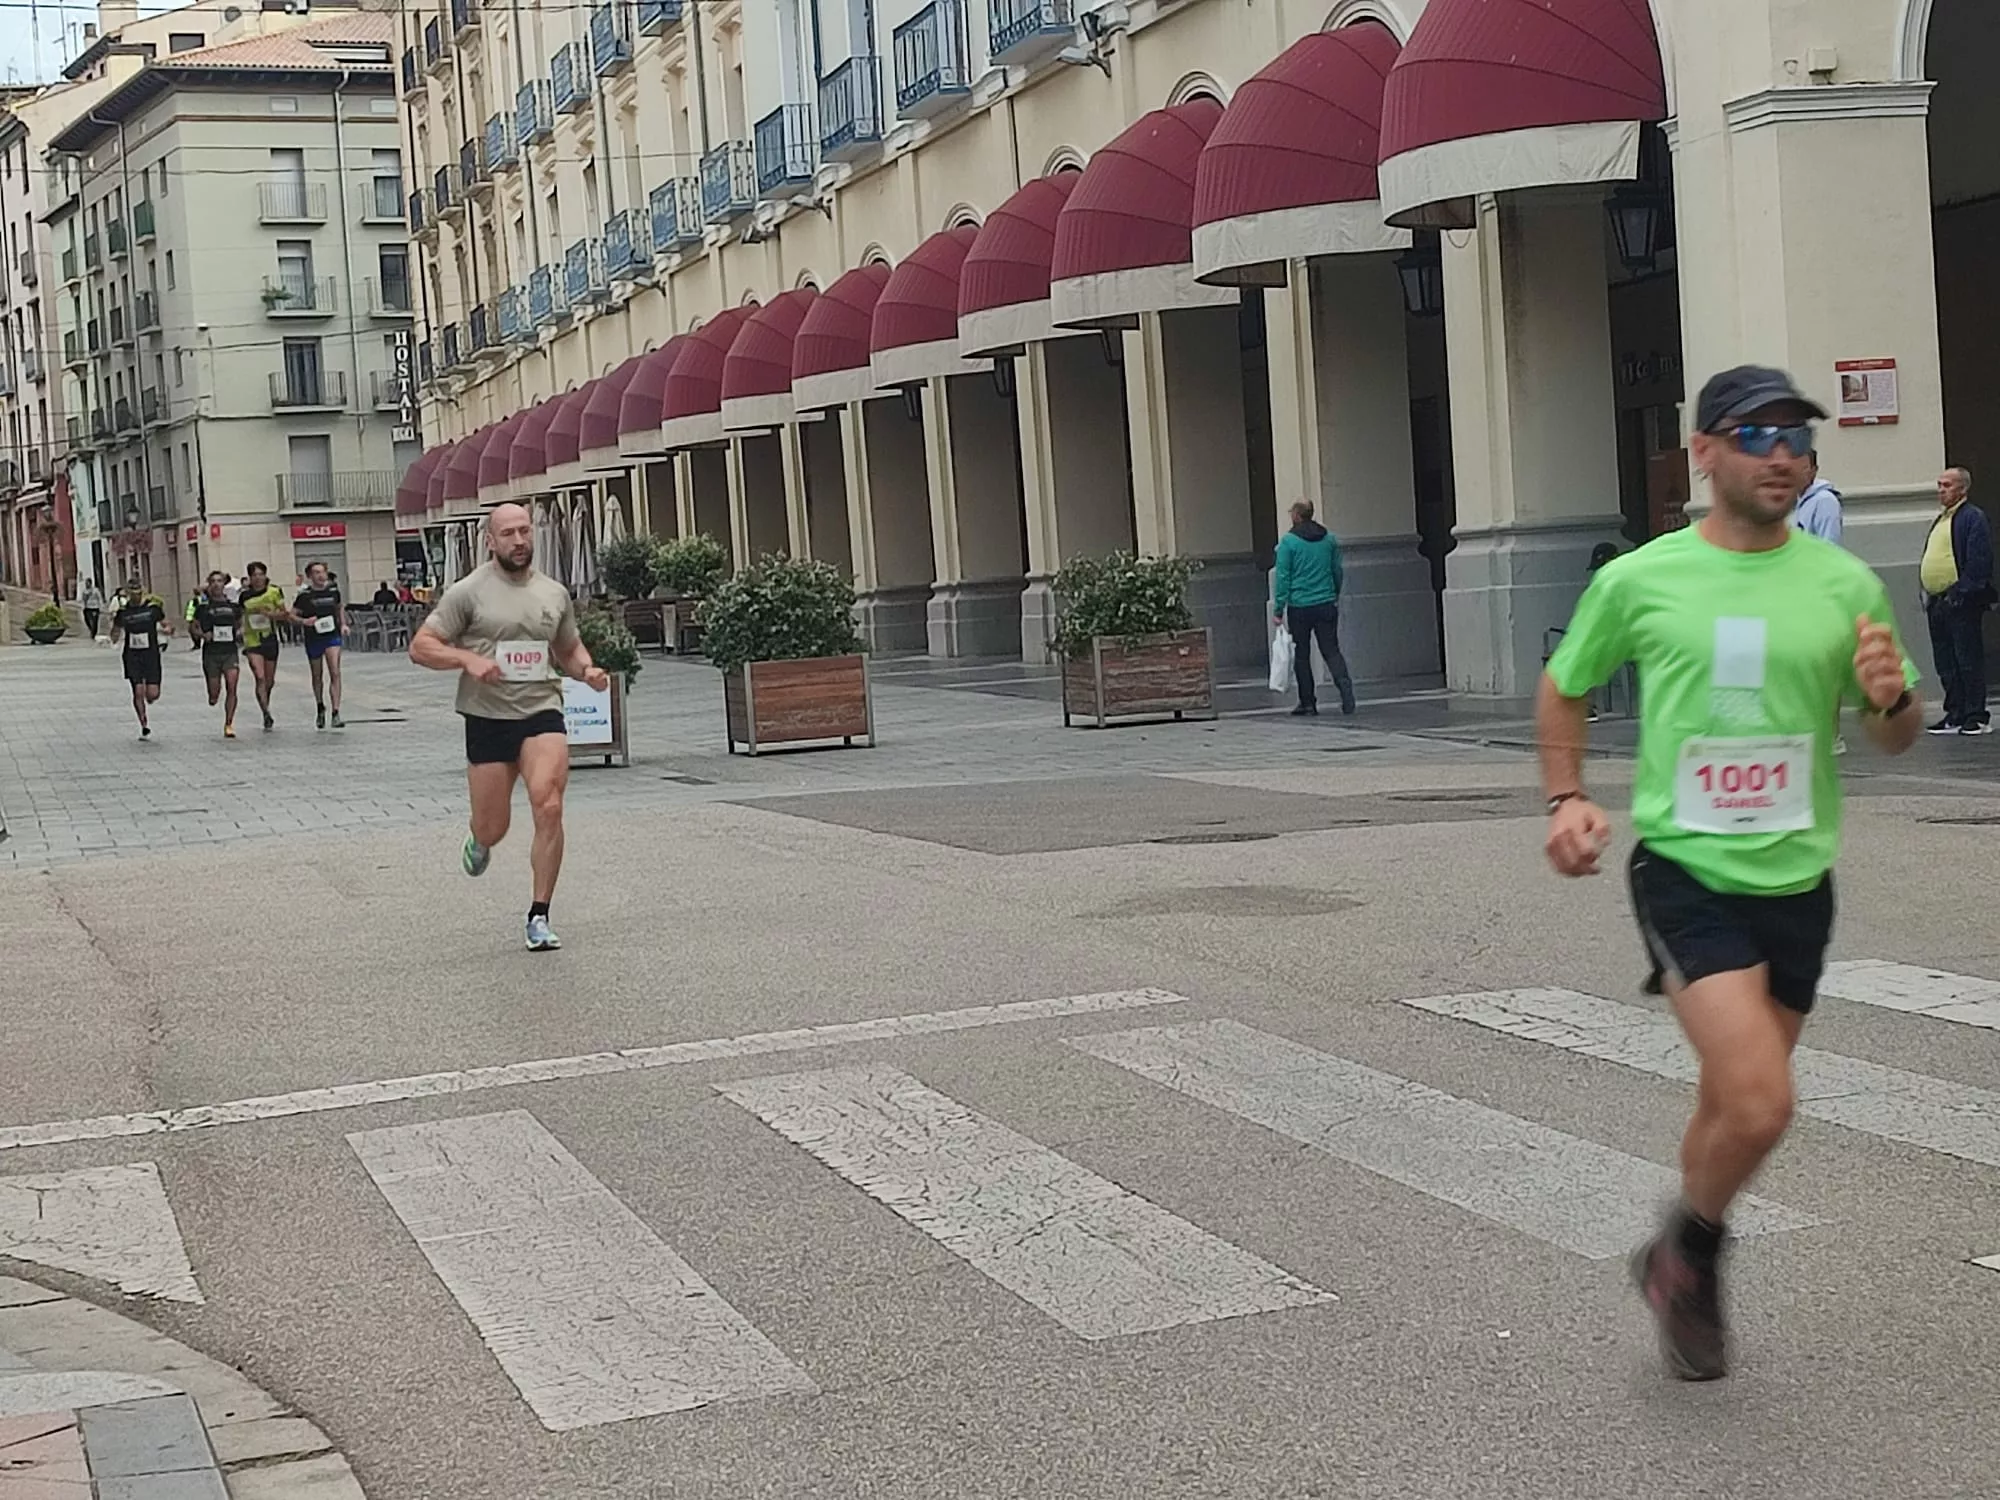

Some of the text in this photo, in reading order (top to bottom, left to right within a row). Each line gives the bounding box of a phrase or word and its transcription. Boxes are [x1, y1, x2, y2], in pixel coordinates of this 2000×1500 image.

[394, 331, 412, 423] HOSTAL
[306, 525, 332, 536] GAES
[505, 651, 542, 664] 1009
[1694, 760, 1789, 793] 1001
